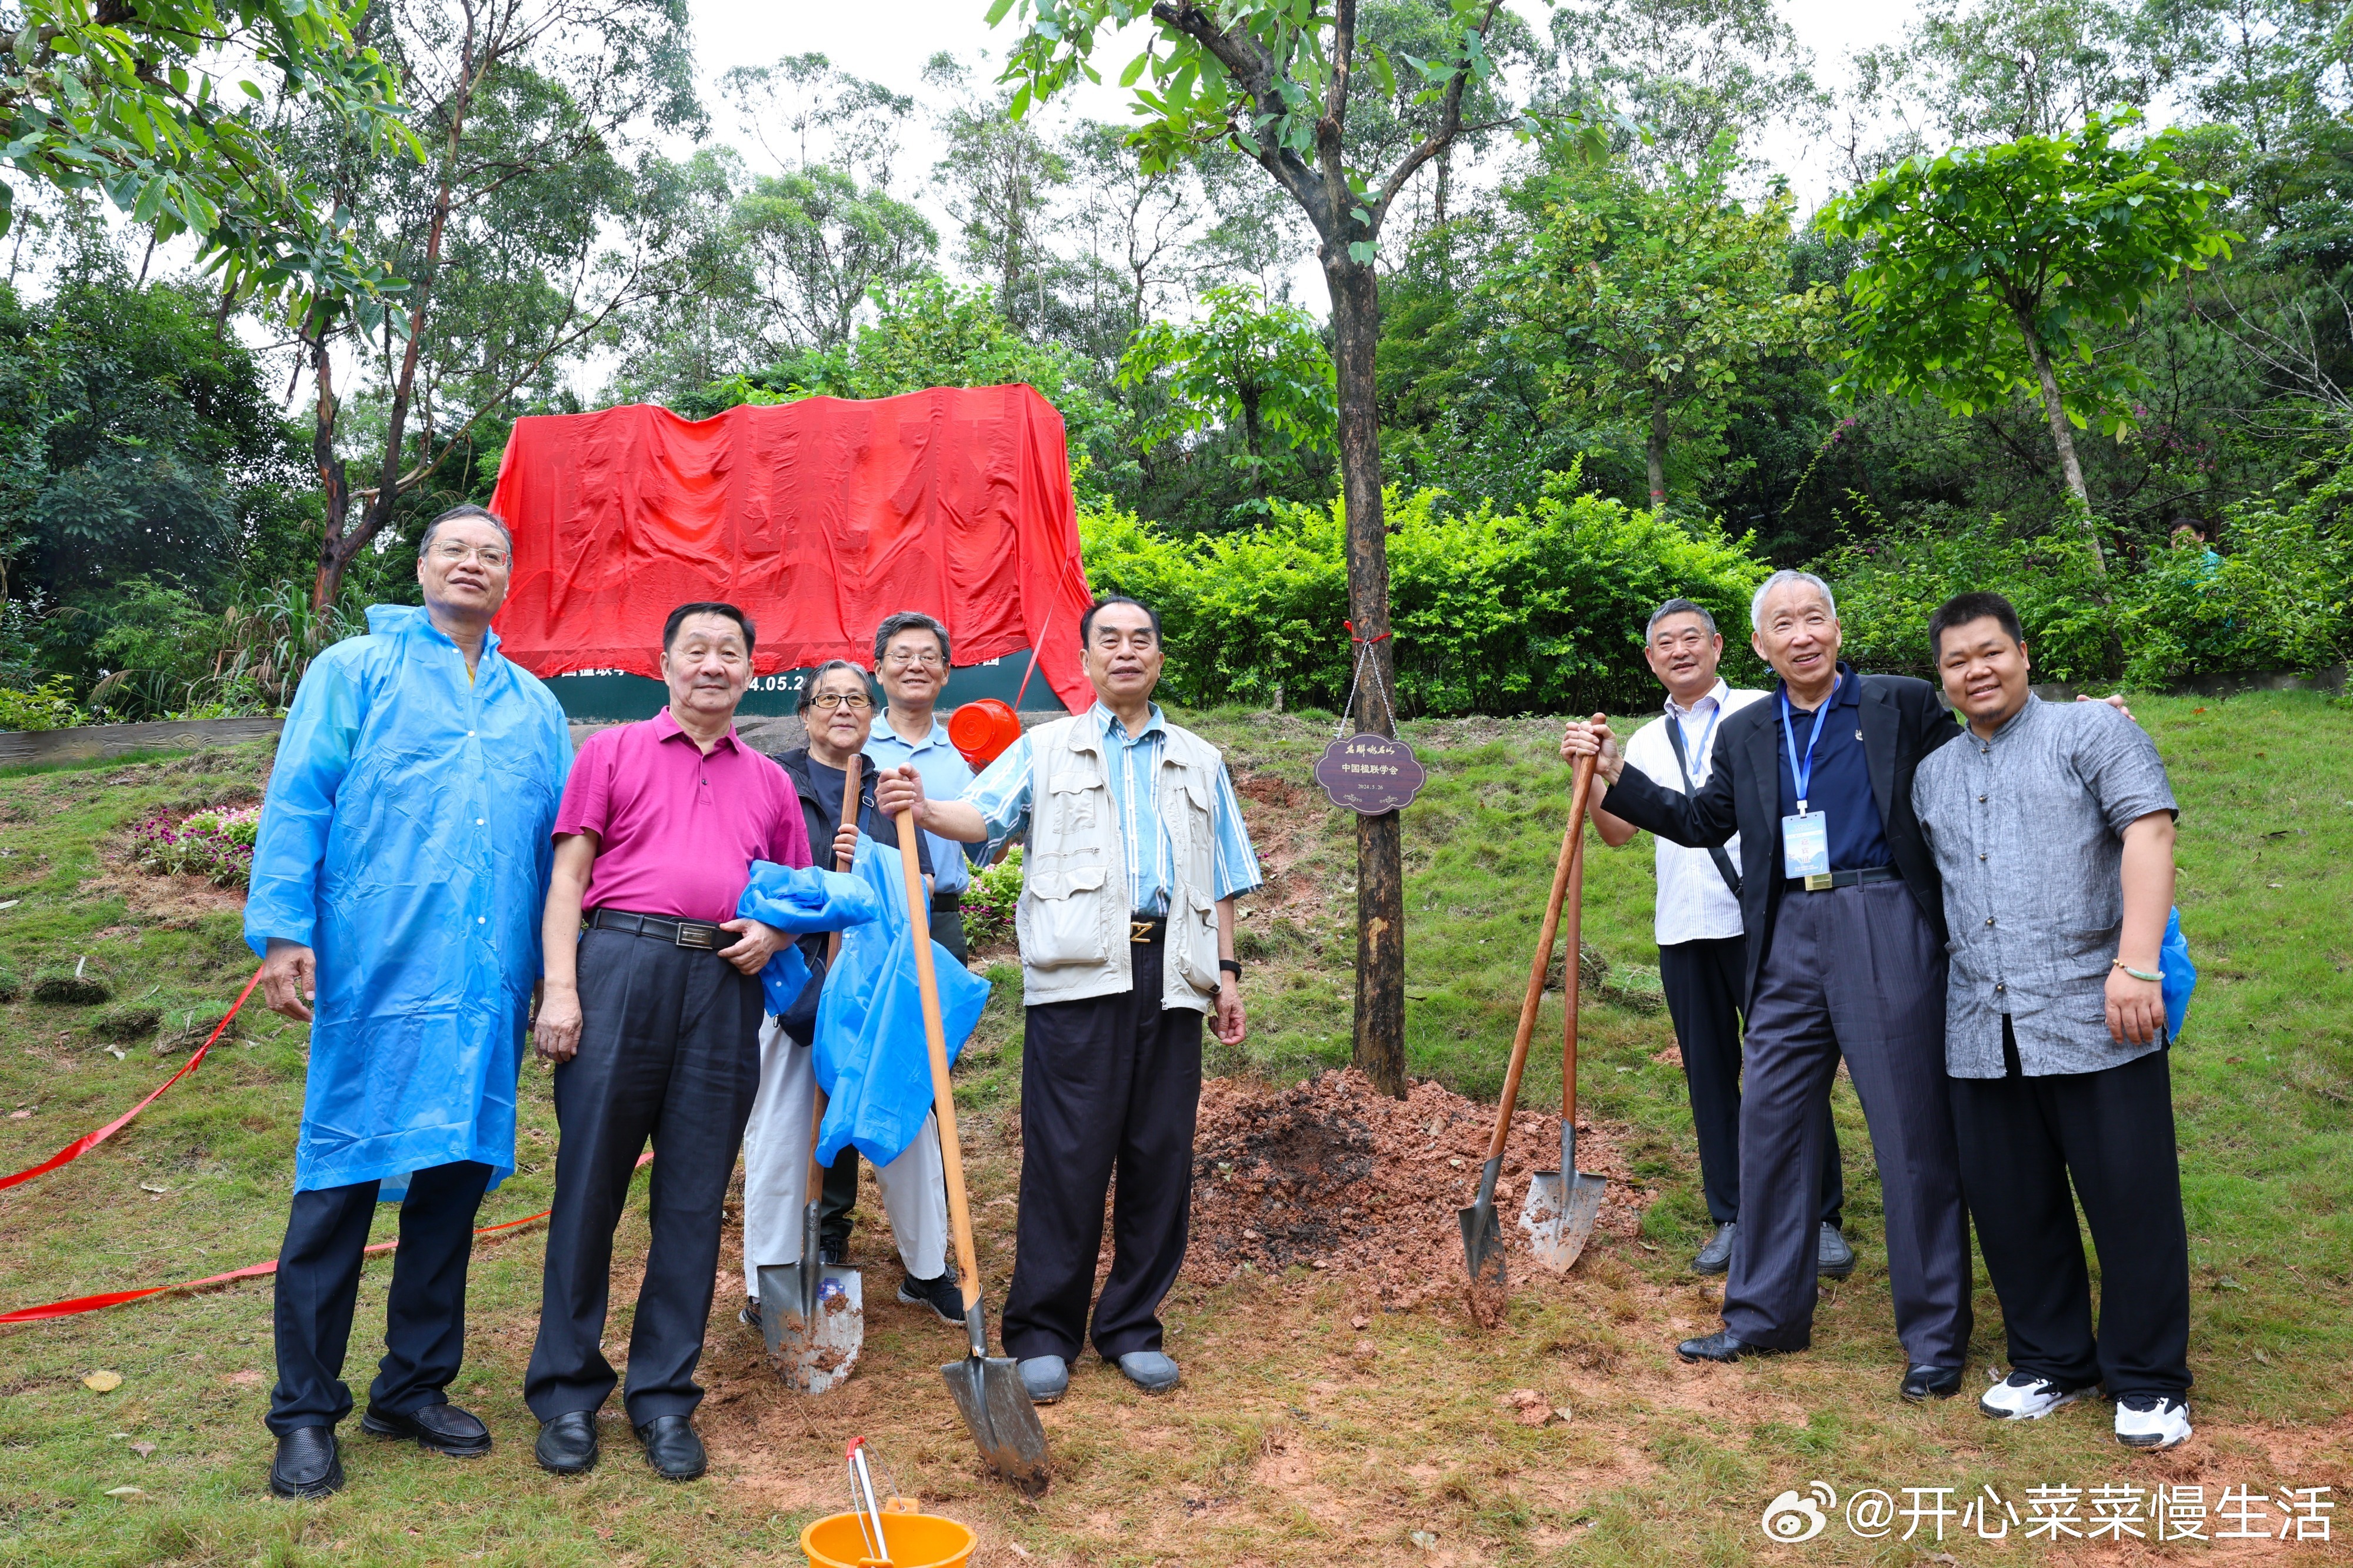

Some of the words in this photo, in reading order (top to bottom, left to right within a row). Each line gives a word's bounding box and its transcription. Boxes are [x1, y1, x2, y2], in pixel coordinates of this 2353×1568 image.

[745, 676, 804, 691] 4.05.2
[1342, 763, 1398, 775] 中国楹联学会
